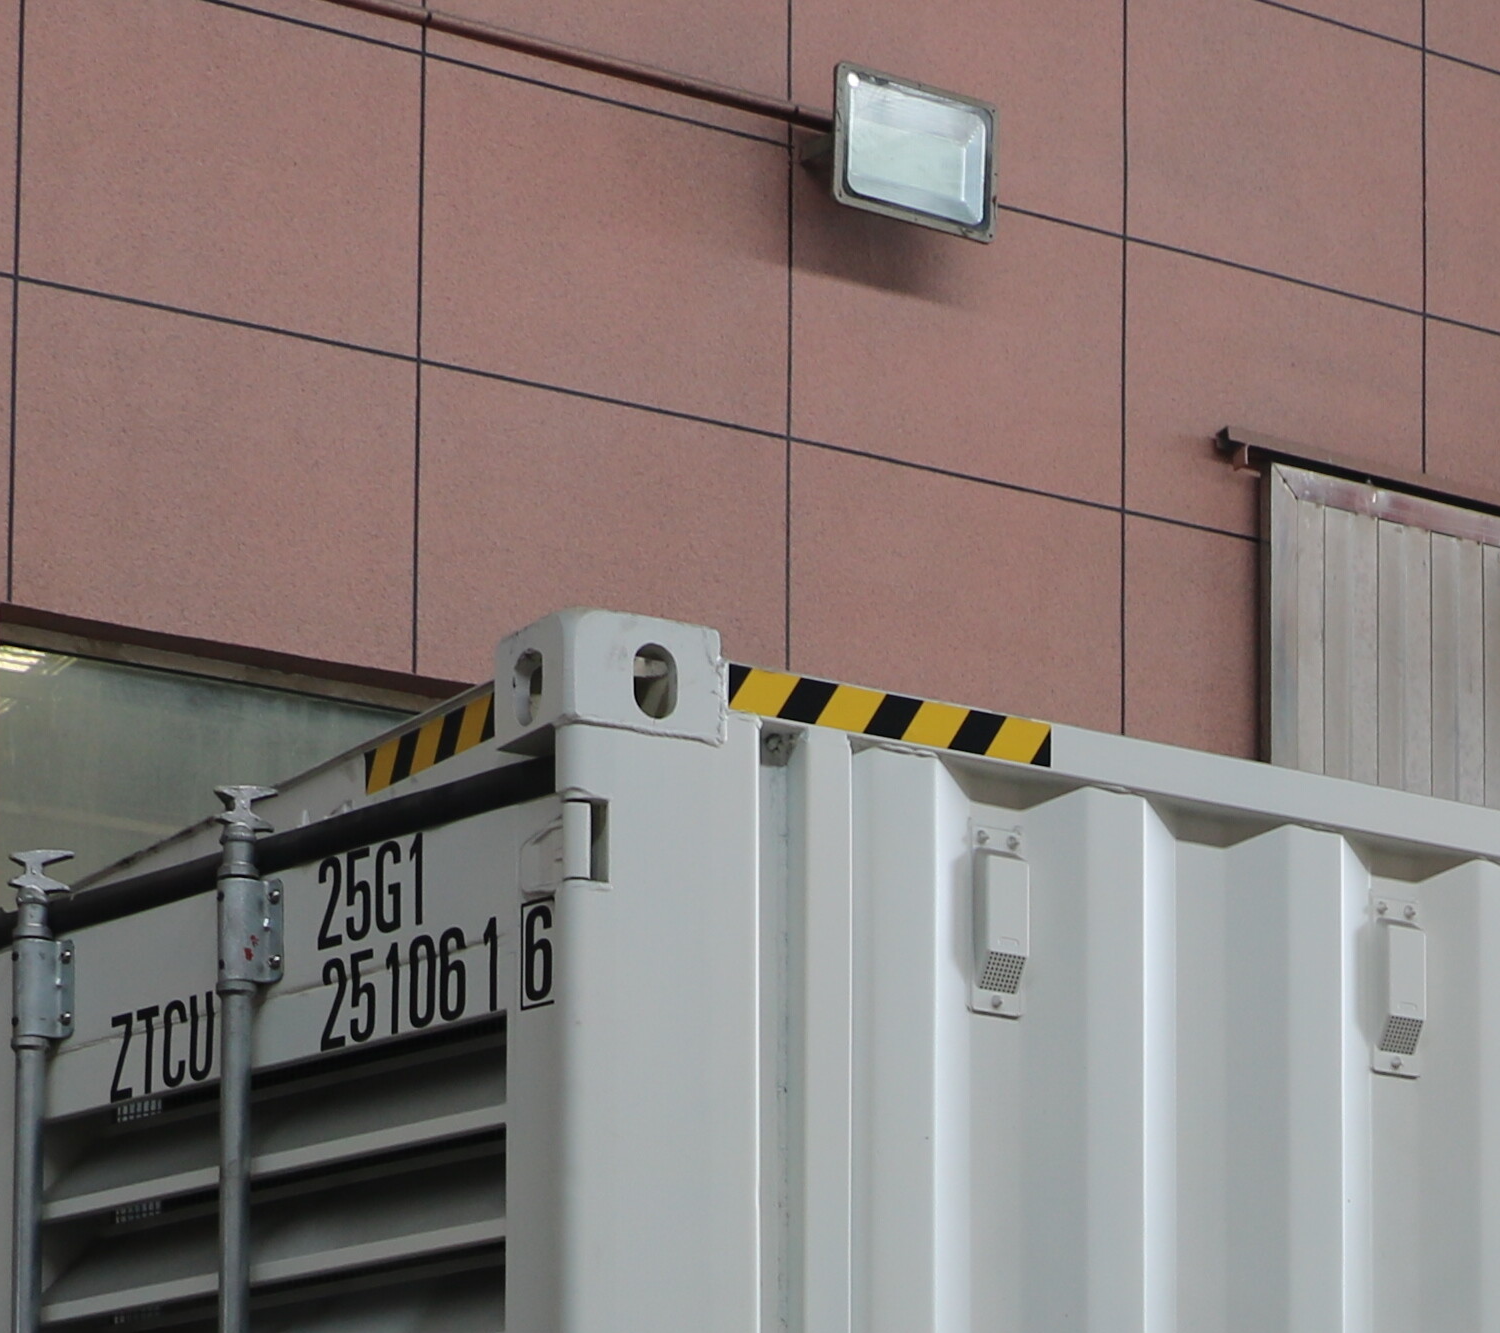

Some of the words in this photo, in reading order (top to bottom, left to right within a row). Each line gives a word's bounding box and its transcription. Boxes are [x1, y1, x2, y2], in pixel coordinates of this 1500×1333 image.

[317, 832, 425, 951] 25G1
[110, 990, 215, 1103] ZTCU
[321, 917, 499, 1052] 251061
[524, 905, 553, 1002] 6
